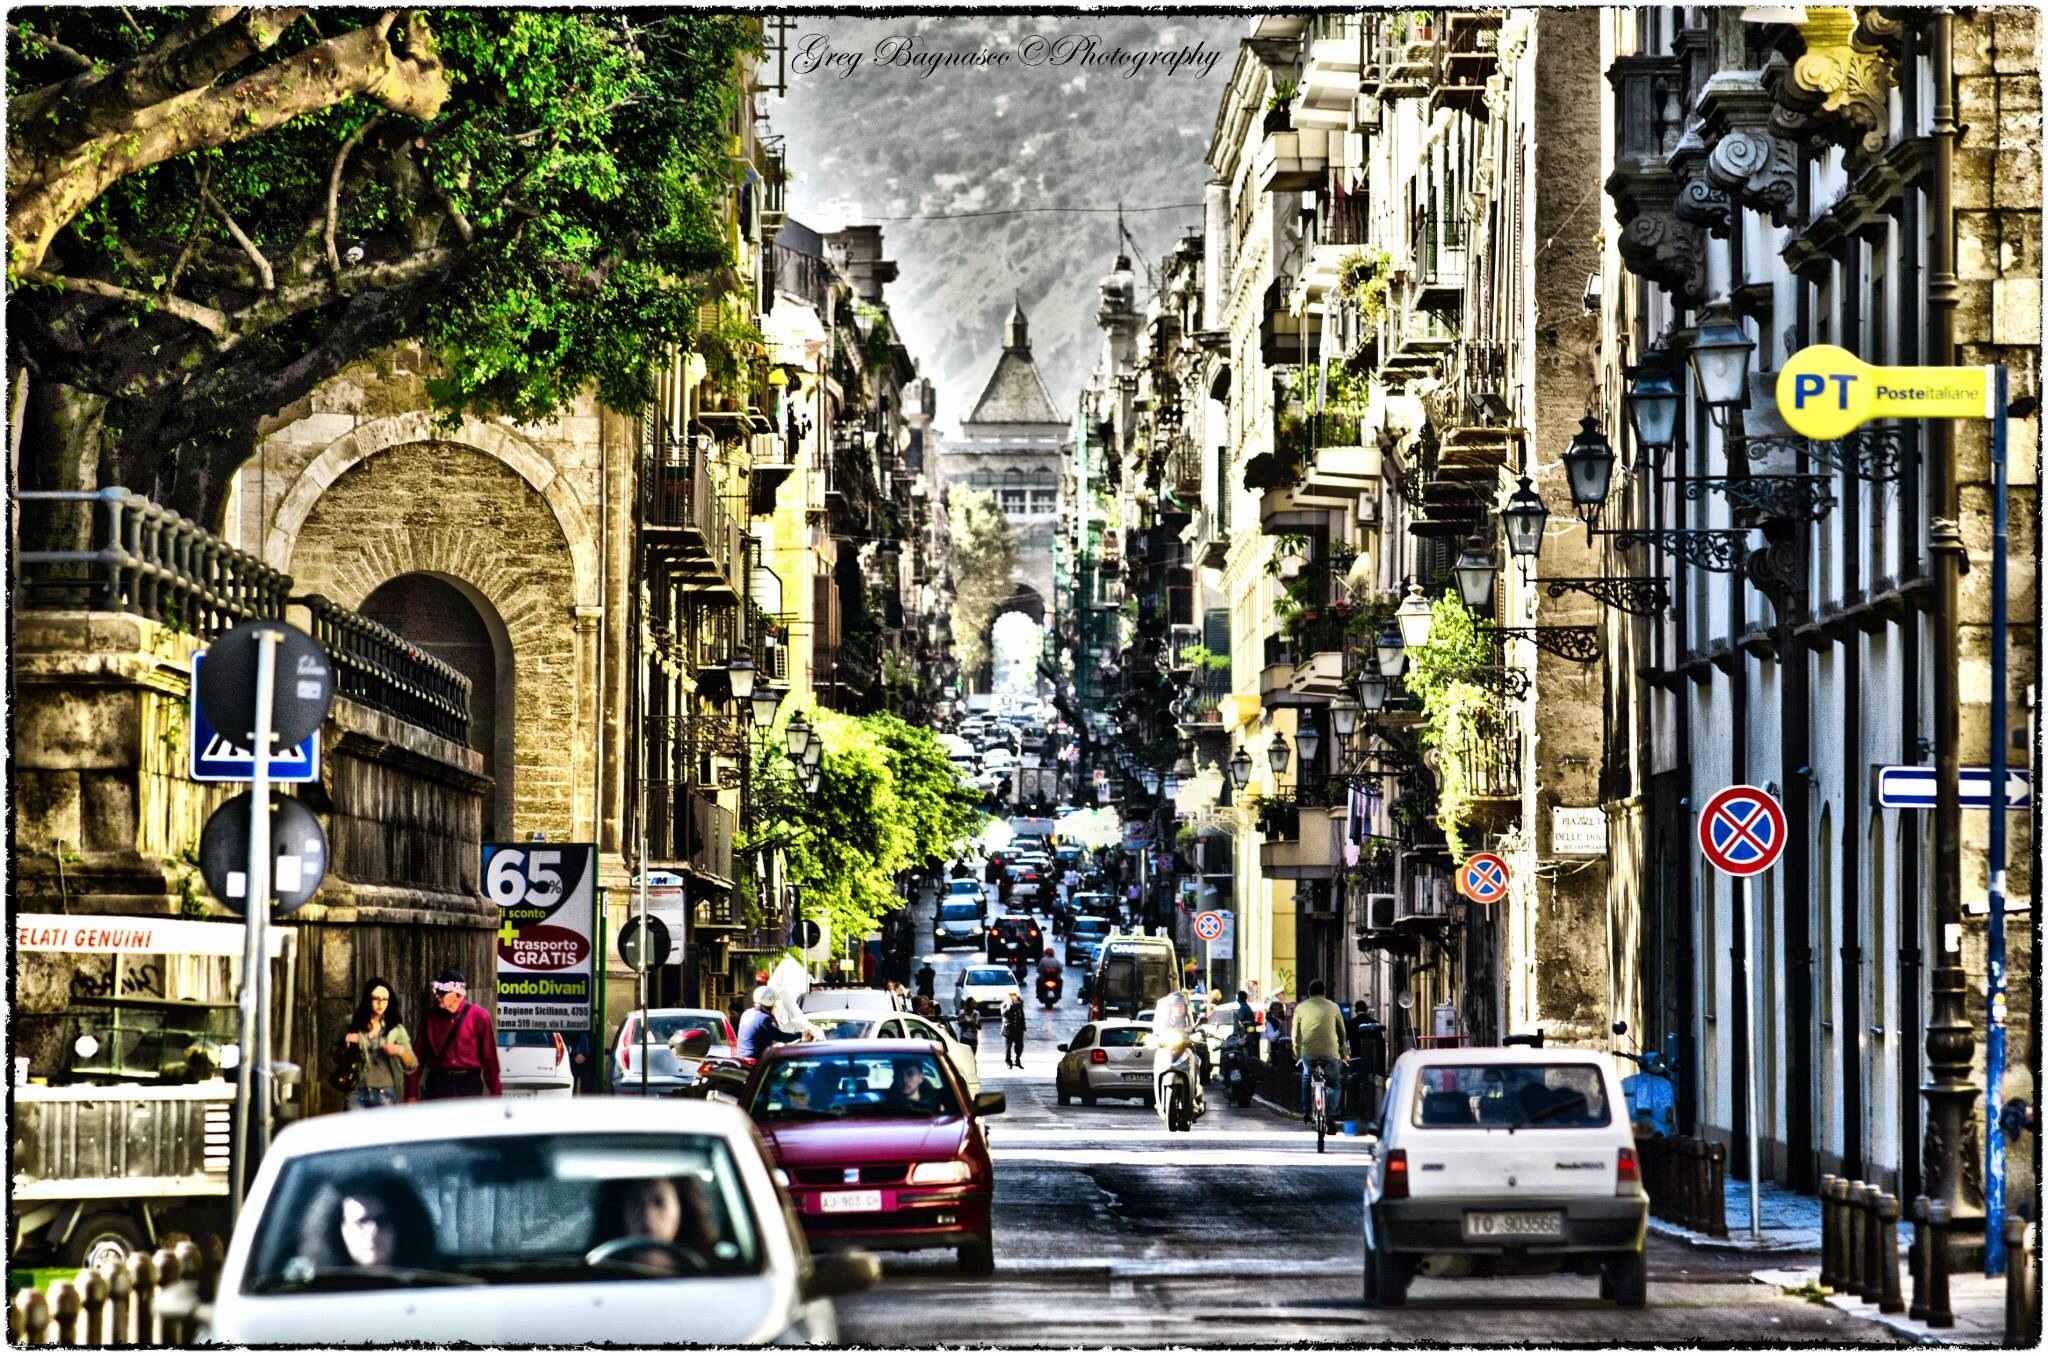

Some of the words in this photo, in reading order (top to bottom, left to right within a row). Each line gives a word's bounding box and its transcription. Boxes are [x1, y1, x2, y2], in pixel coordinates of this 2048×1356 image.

[1794, 373, 1858, 410] PT
[1555, 832, 1581, 841] DELLE
[508, 909, 546, 919] sconto
[74, 929, 153, 948] GENUINI
[513, 939, 578, 952] trasporto
[513, 951, 577, 965] GRATIS
[503, 1007, 533, 1016] Regione
